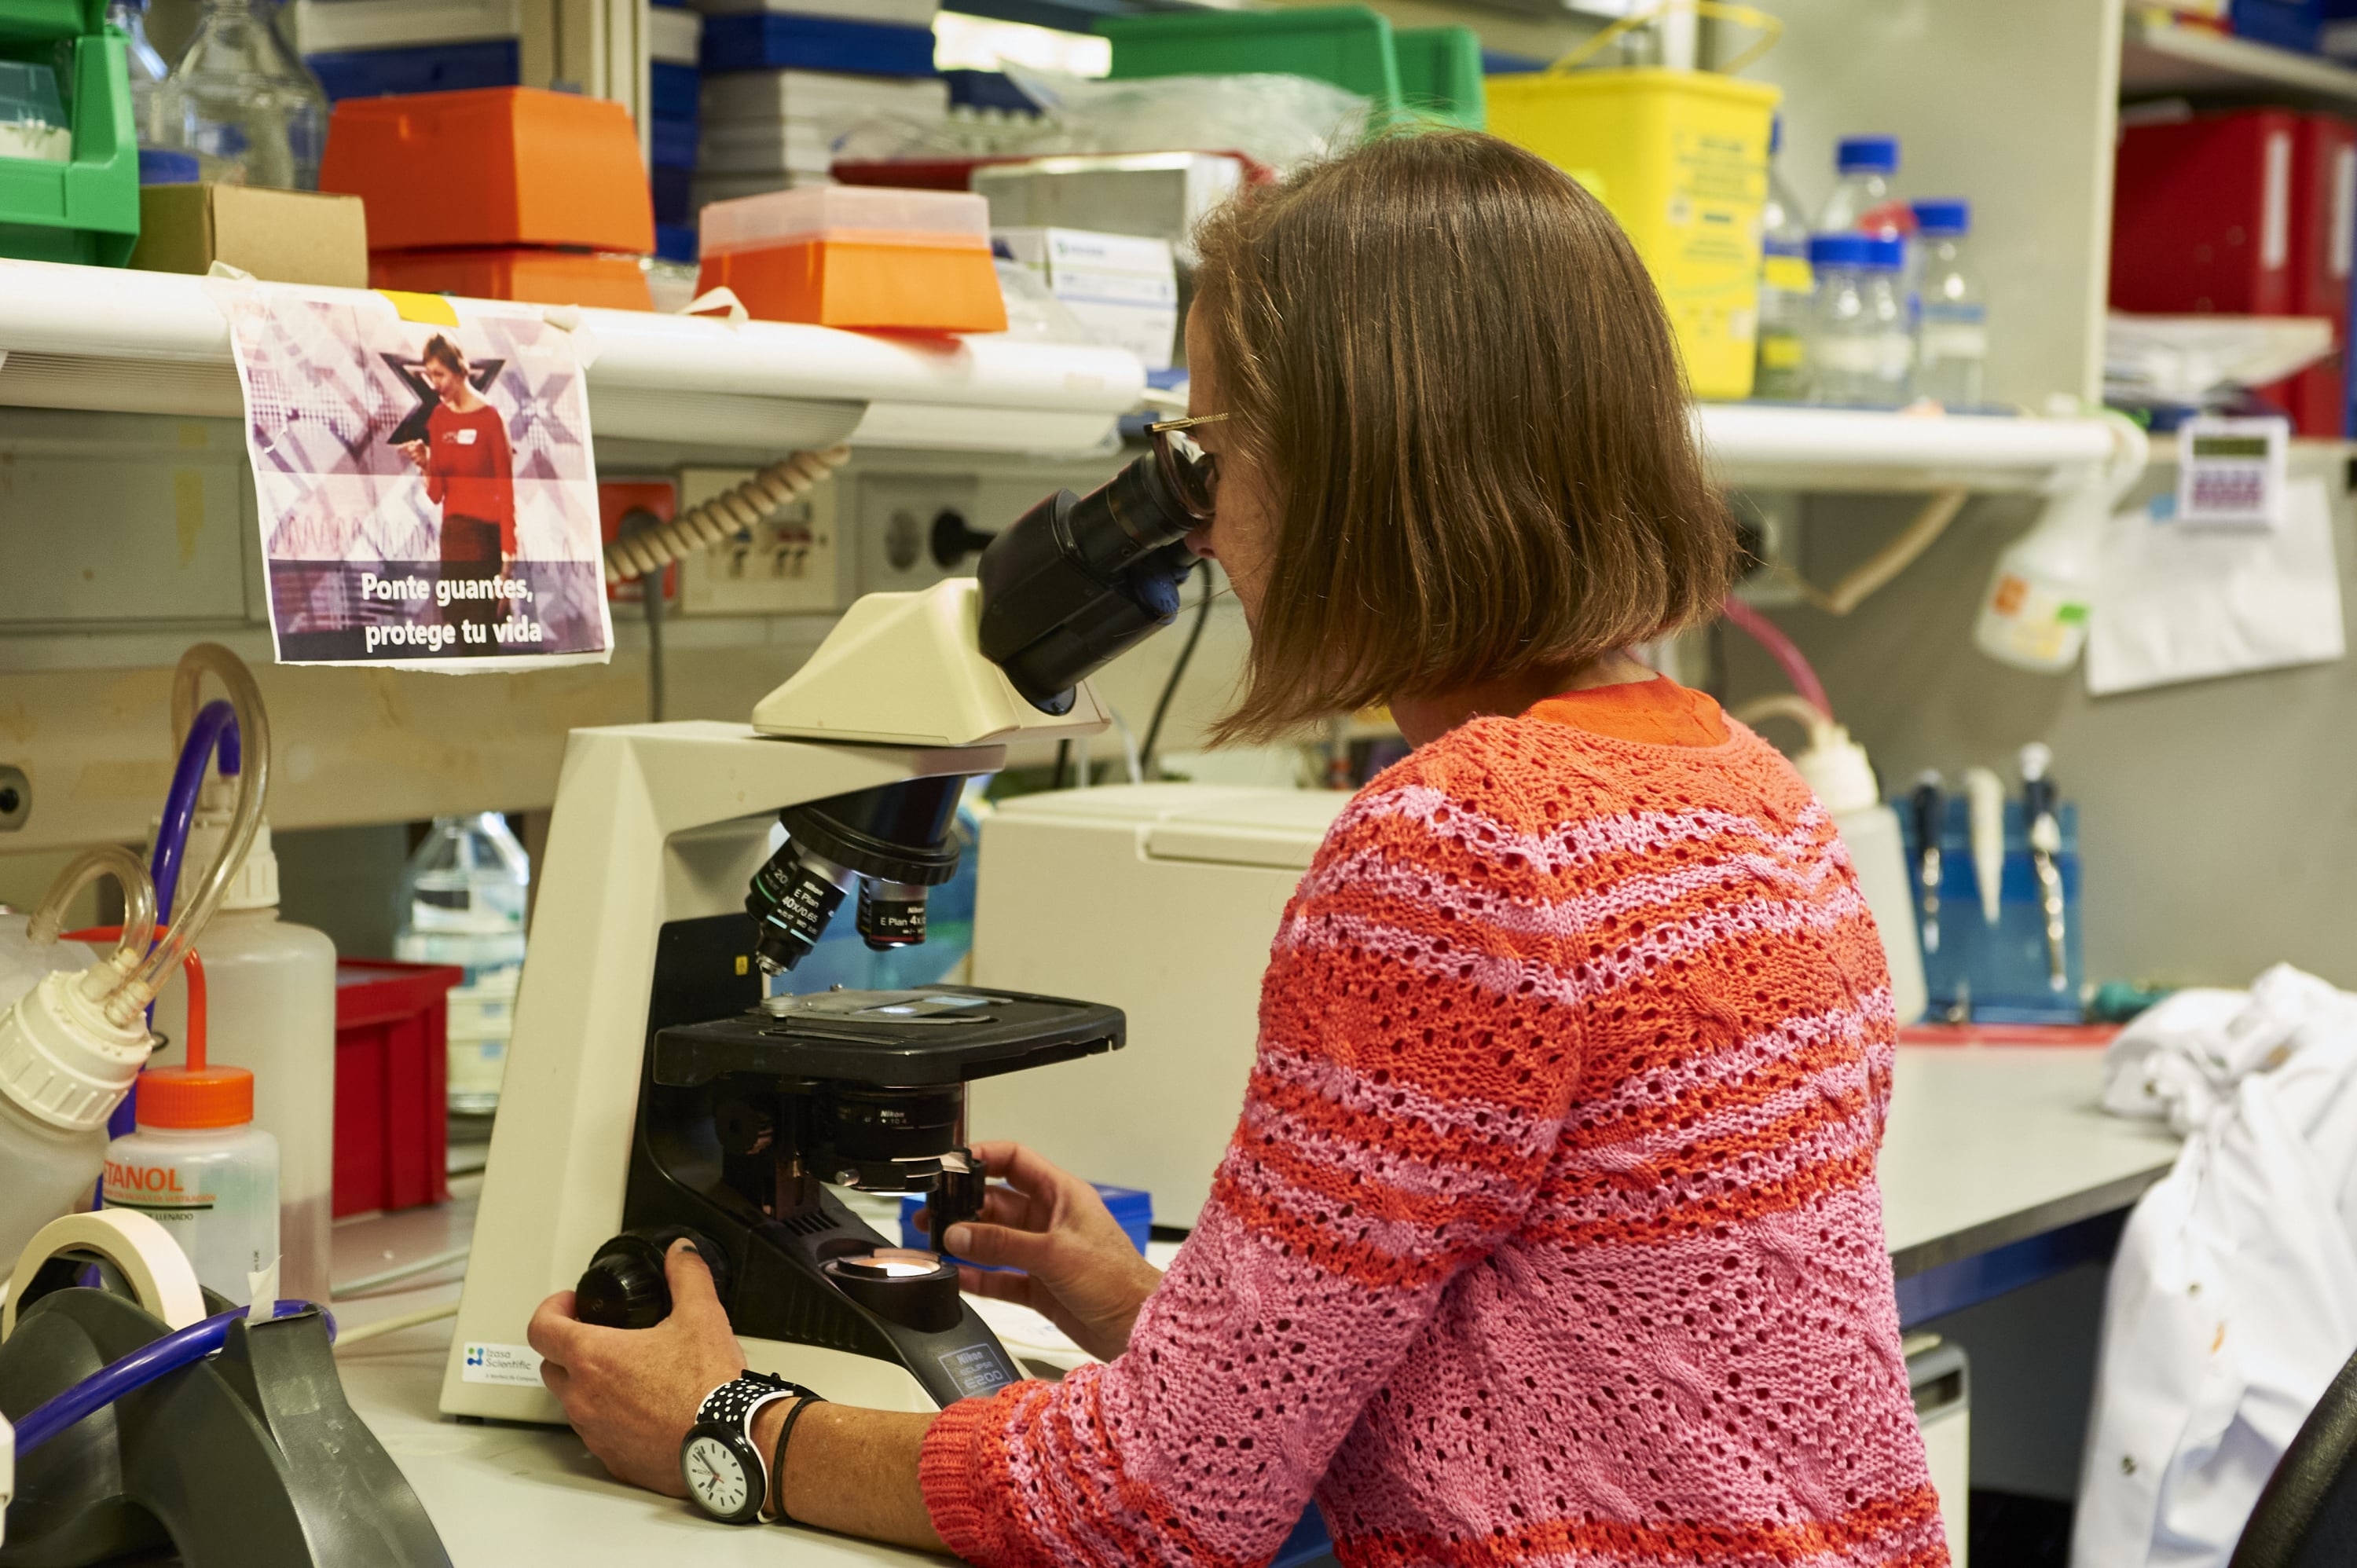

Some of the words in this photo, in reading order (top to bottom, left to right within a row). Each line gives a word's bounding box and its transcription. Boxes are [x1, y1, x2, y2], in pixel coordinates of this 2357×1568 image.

[361, 572, 431, 600] Ponte
[434, 574, 533, 607] guantes,
[365, 620, 456, 654] protege
[461, 618, 487, 643] tu
[492, 614, 542, 643] vida
[803, 881, 824, 896] Nikon
[794, 888, 802, 898] E
[801, 892, 819, 908] Plan
[880, 917, 886, 926] E
[889, 917, 908, 926] Plan
[880, 1109, 905, 1118] Nikon
[155, 1213, 193, 1222] LLENADO
[486, 1347, 511, 1358] Izasa
[955, 1351, 984, 1365] Nikon
[486, 1357, 532, 1370] Scientific
[963, 1369, 1003, 1390] E200
